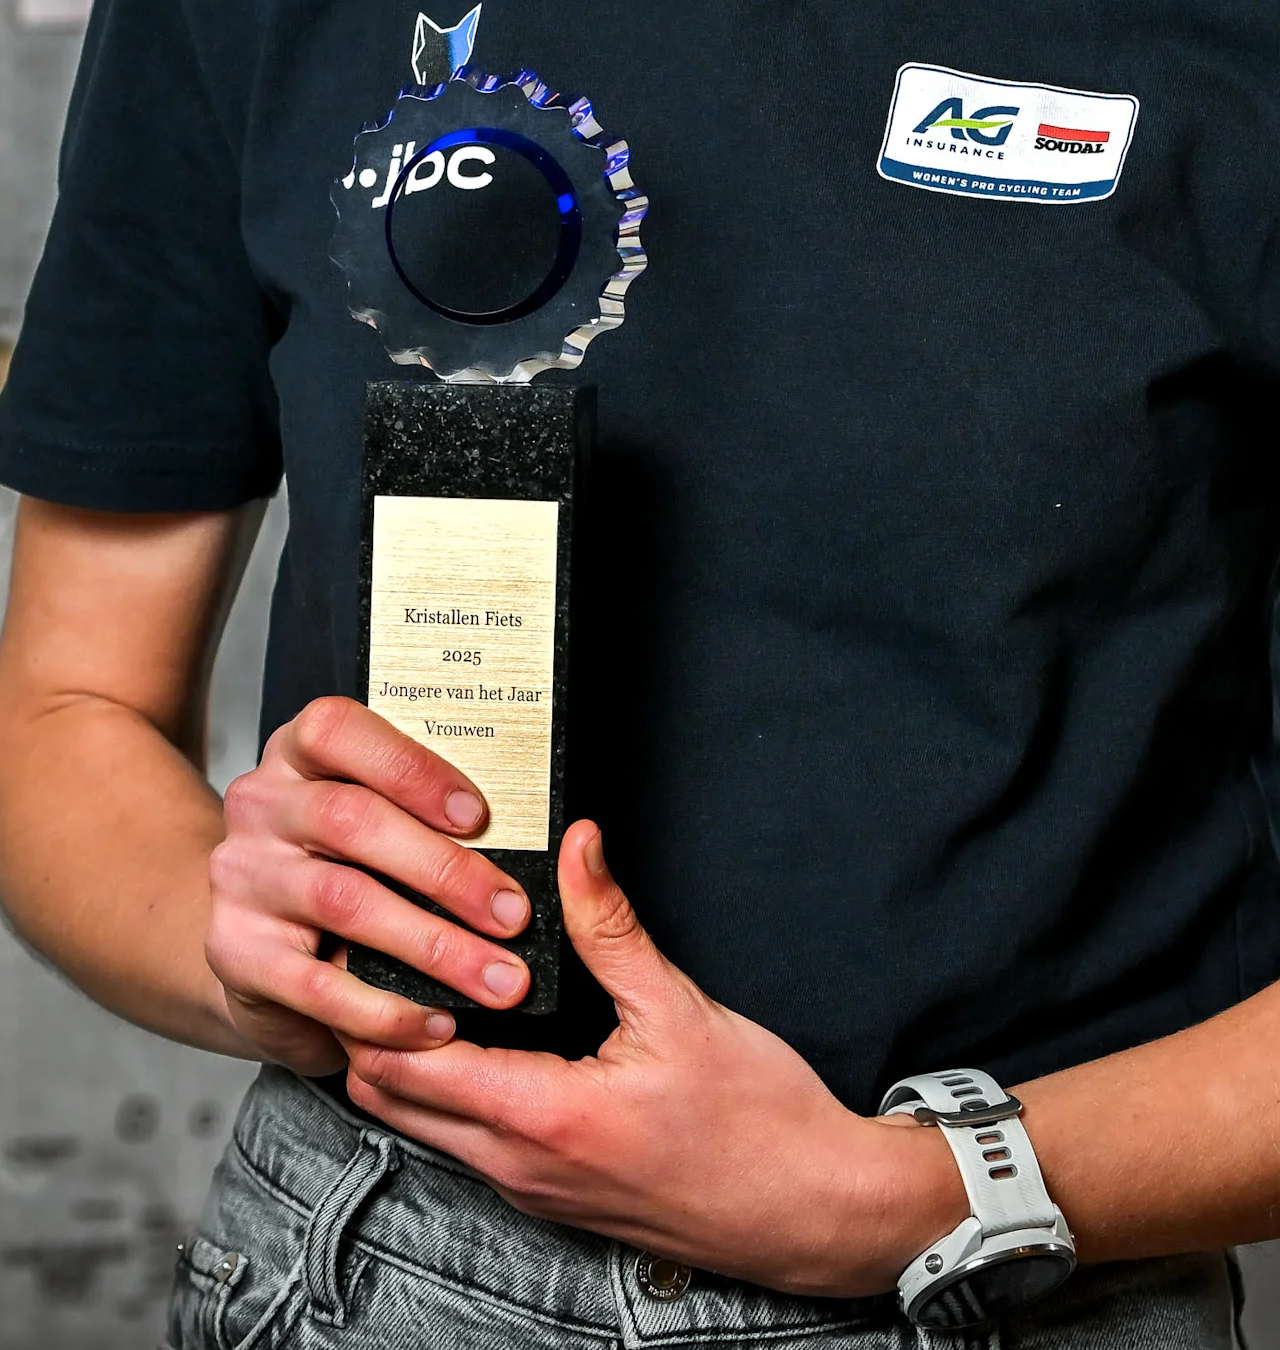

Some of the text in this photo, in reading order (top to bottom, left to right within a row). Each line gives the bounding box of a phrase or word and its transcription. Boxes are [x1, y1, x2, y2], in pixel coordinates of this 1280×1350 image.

[912, 97, 1020, 146] AG
[906, 137, 1006, 160] INSURANCE
[1034, 137, 1105, 154] SOUDAL
[913, 171, 1081, 197] WOMEN'S PRO CYCLING TEAM
[404, 608, 522, 627] Kristallen Fiets
[442, 650, 482, 666] 2025
[379, 682, 542, 702] Jongere van het Jaar
[424, 720, 495, 738] Vrouwen
